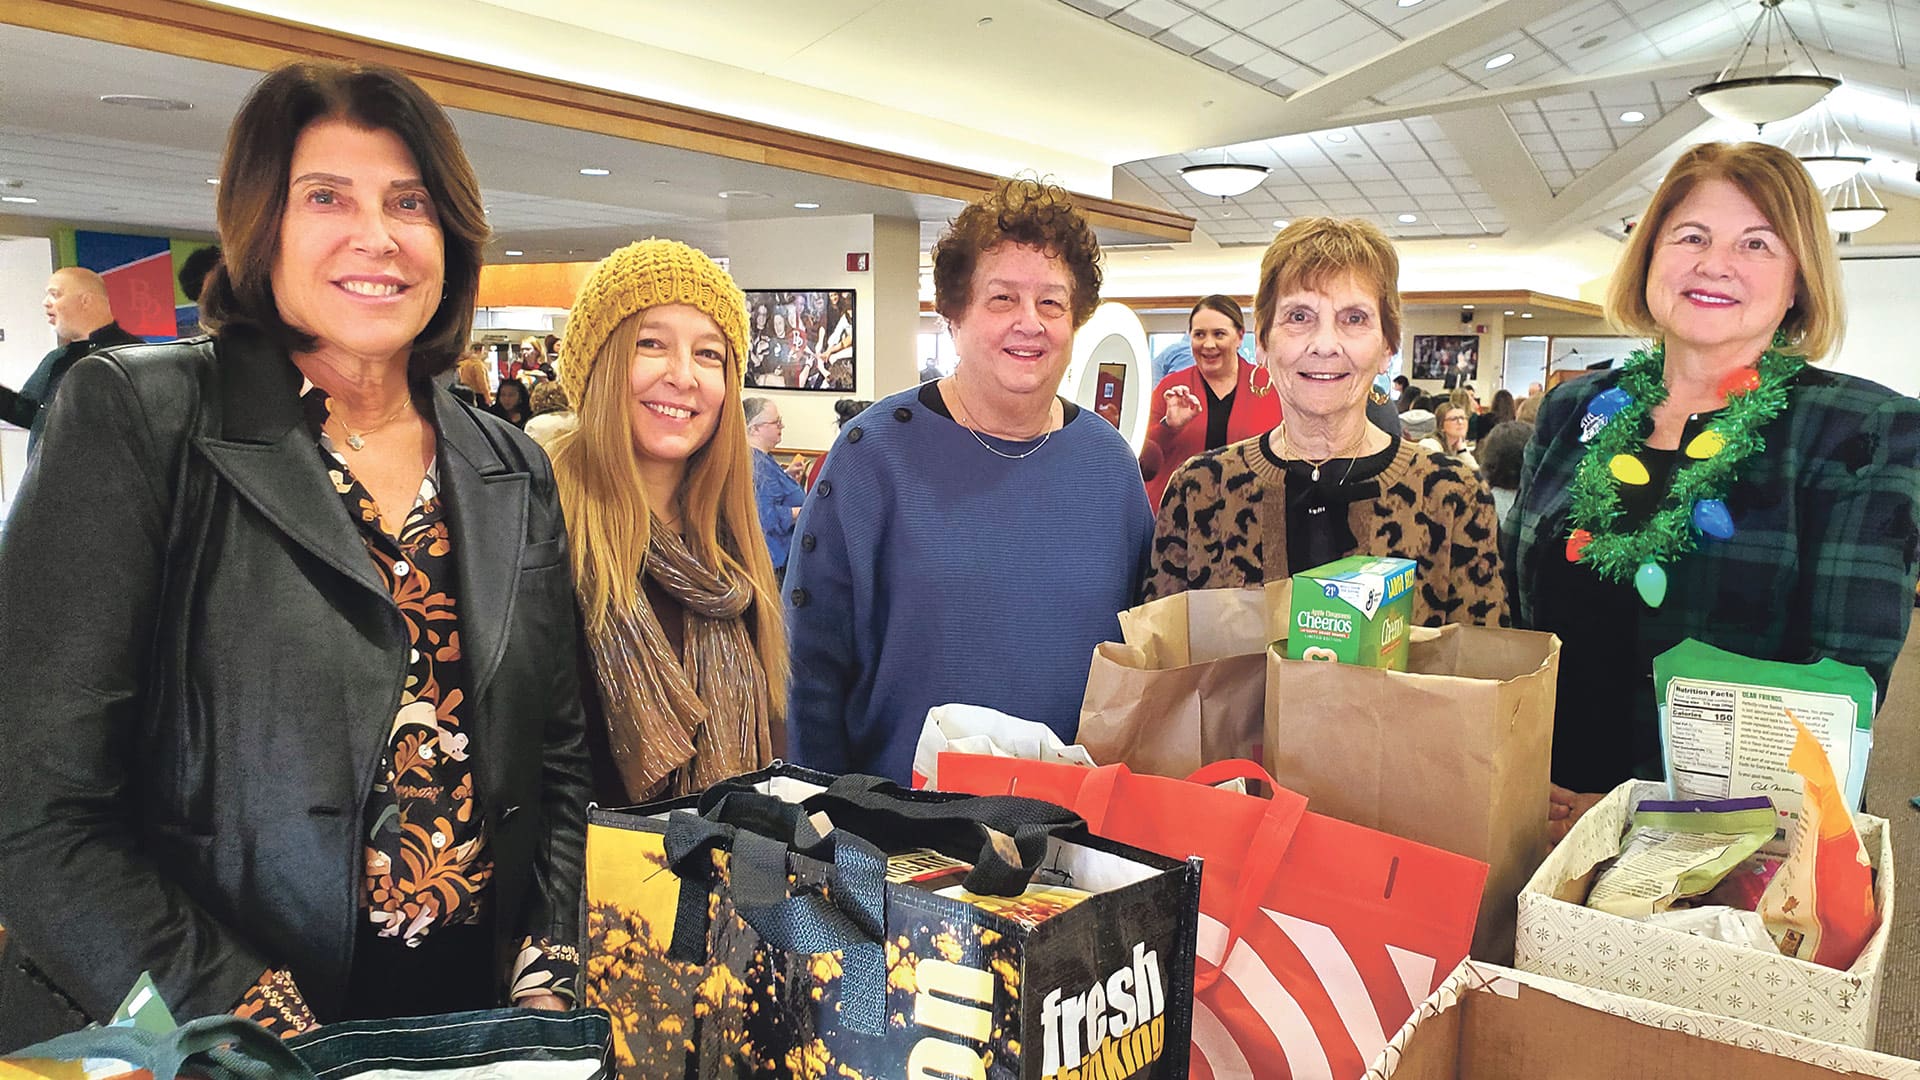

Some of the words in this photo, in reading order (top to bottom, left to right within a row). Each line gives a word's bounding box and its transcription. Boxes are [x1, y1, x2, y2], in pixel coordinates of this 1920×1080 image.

[1297, 610, 1352, 633] Cheerios
[1676, 685, 1708, 696] Nutrition
[1710, 690, 1733, 698] Facts
[1741, 691, 1757, 699] DEAR
[1672, 709, 1702, 718] Calories
[1714, 713, 1733, 722] 150
[1040, 941, 1165, 1076] fresh
